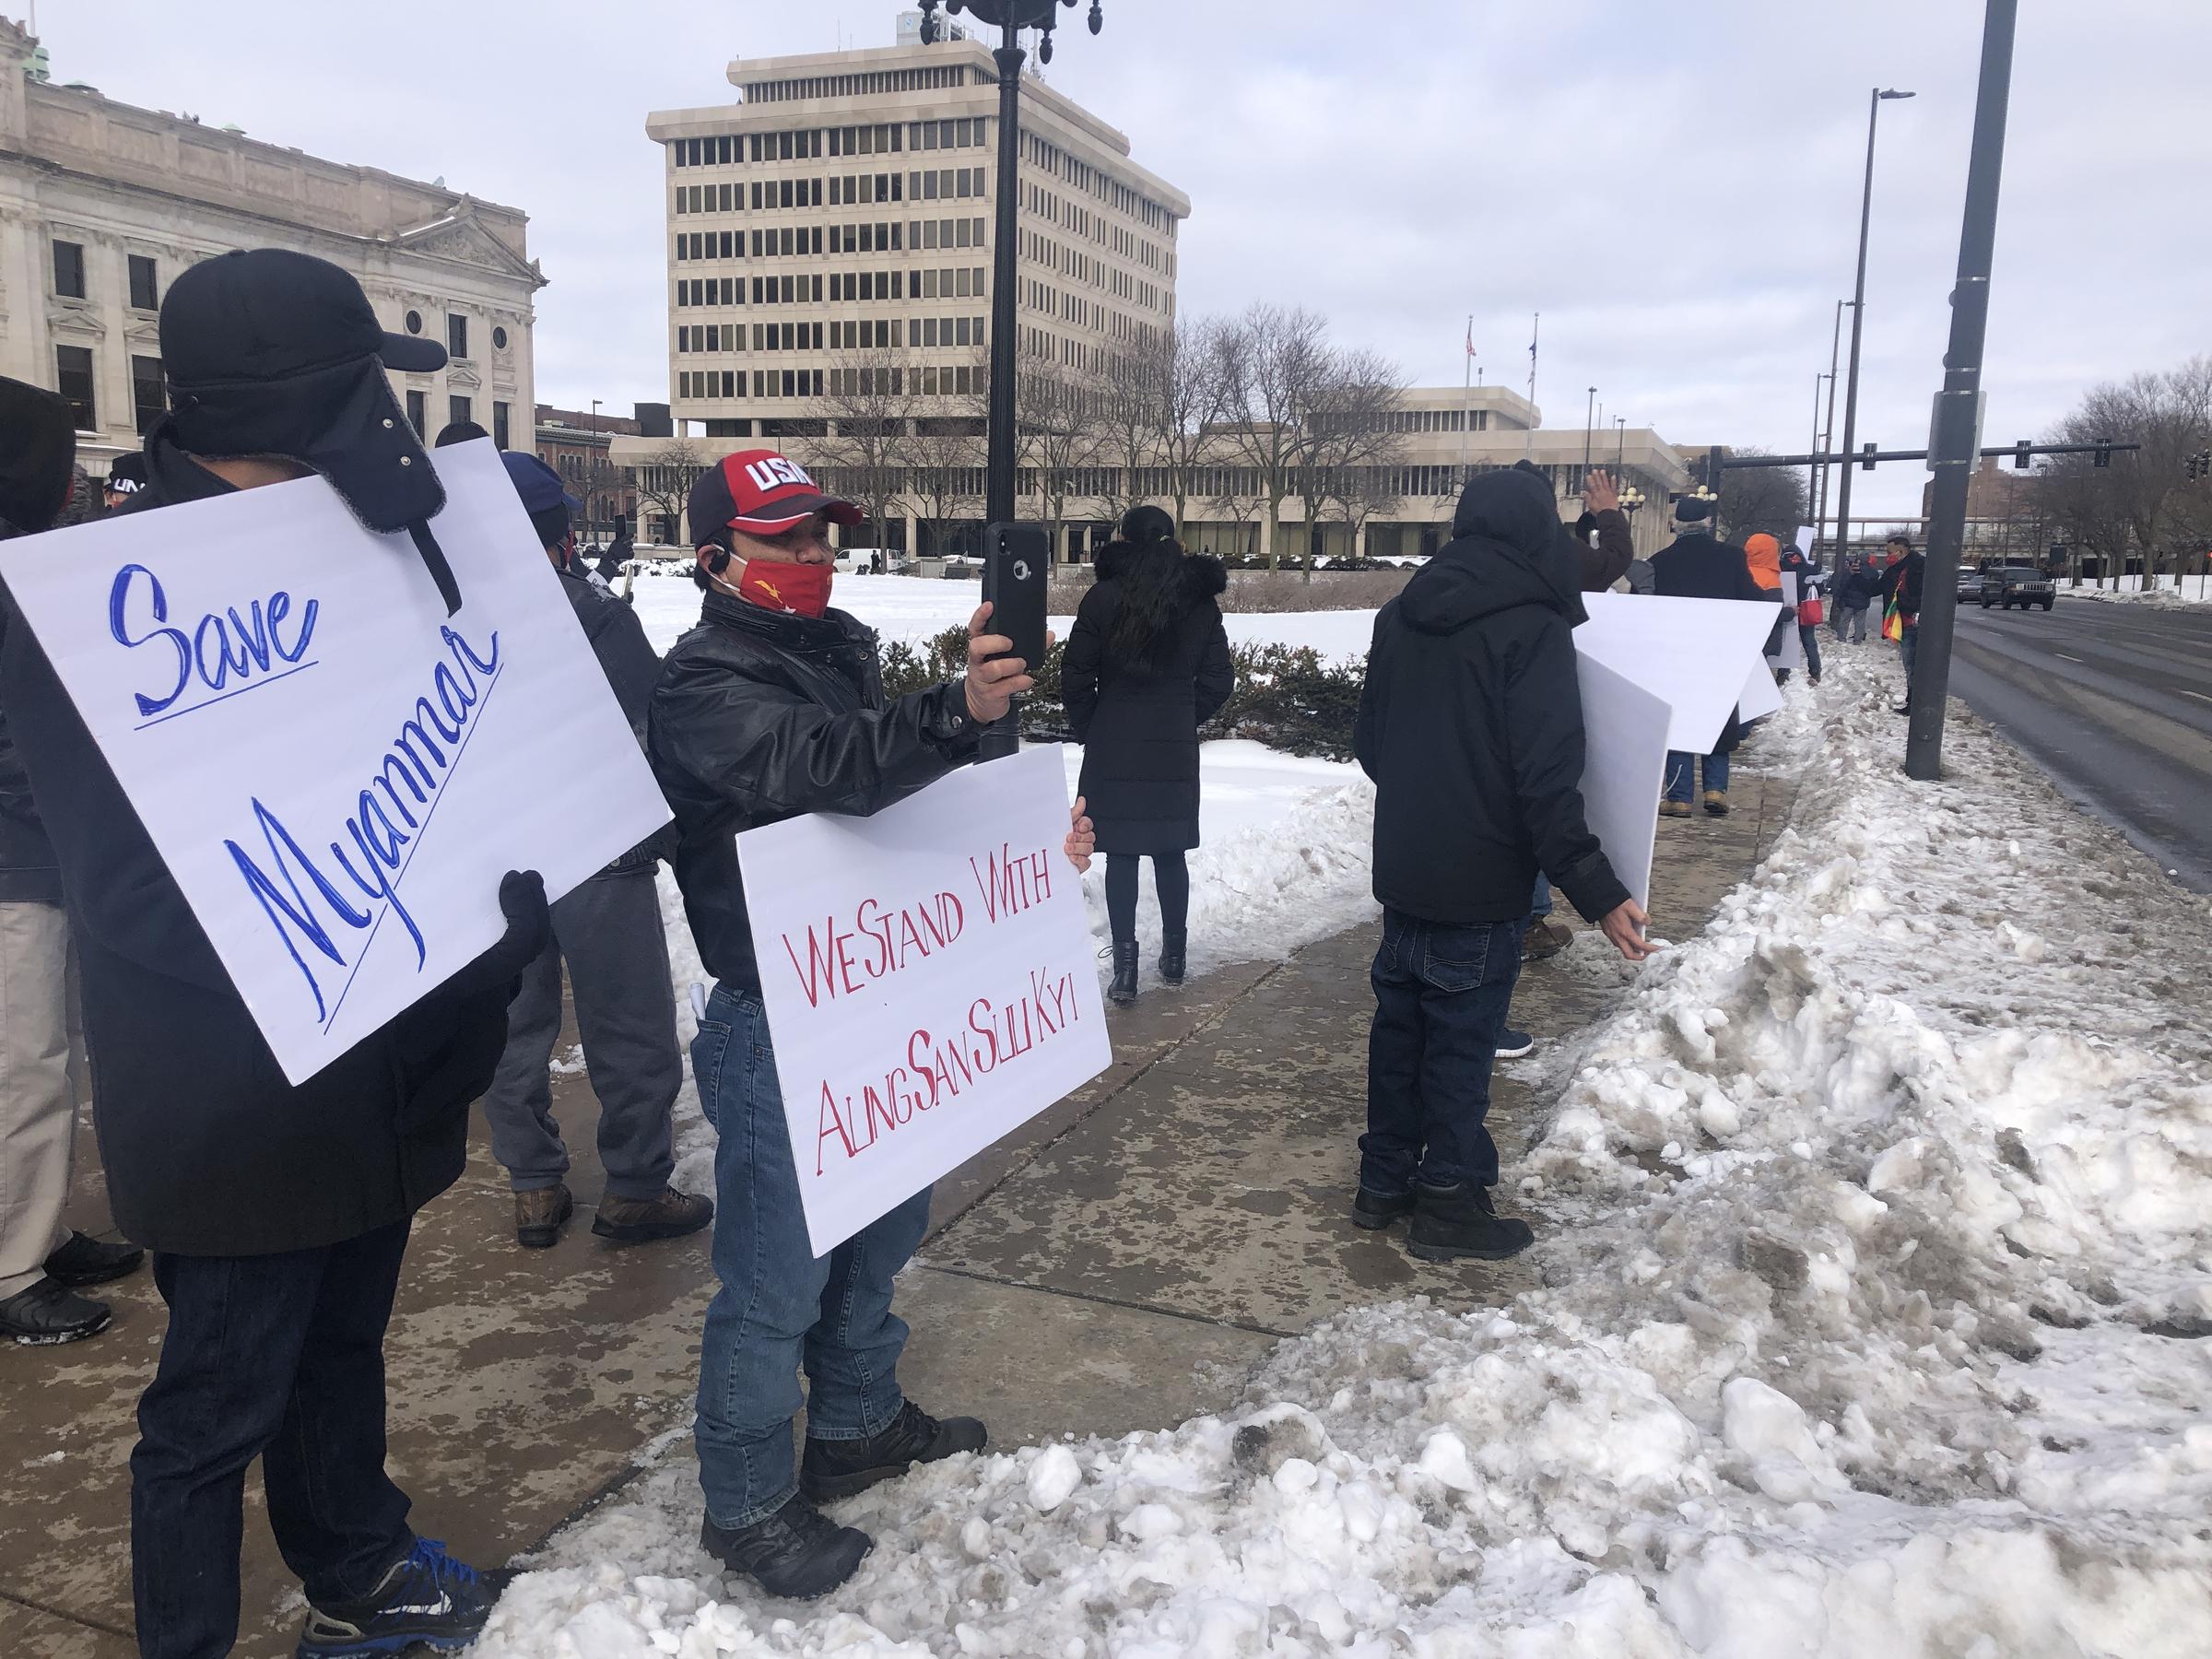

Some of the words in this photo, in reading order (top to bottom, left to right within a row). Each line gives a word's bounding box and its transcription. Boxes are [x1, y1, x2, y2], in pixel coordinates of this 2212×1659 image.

[745, 457, 816, 491] USA
[110, 563, 319, 717] Save
[223, 625, 500, 1023] Myanmar
[969, 842, 1053, 924] WITH
